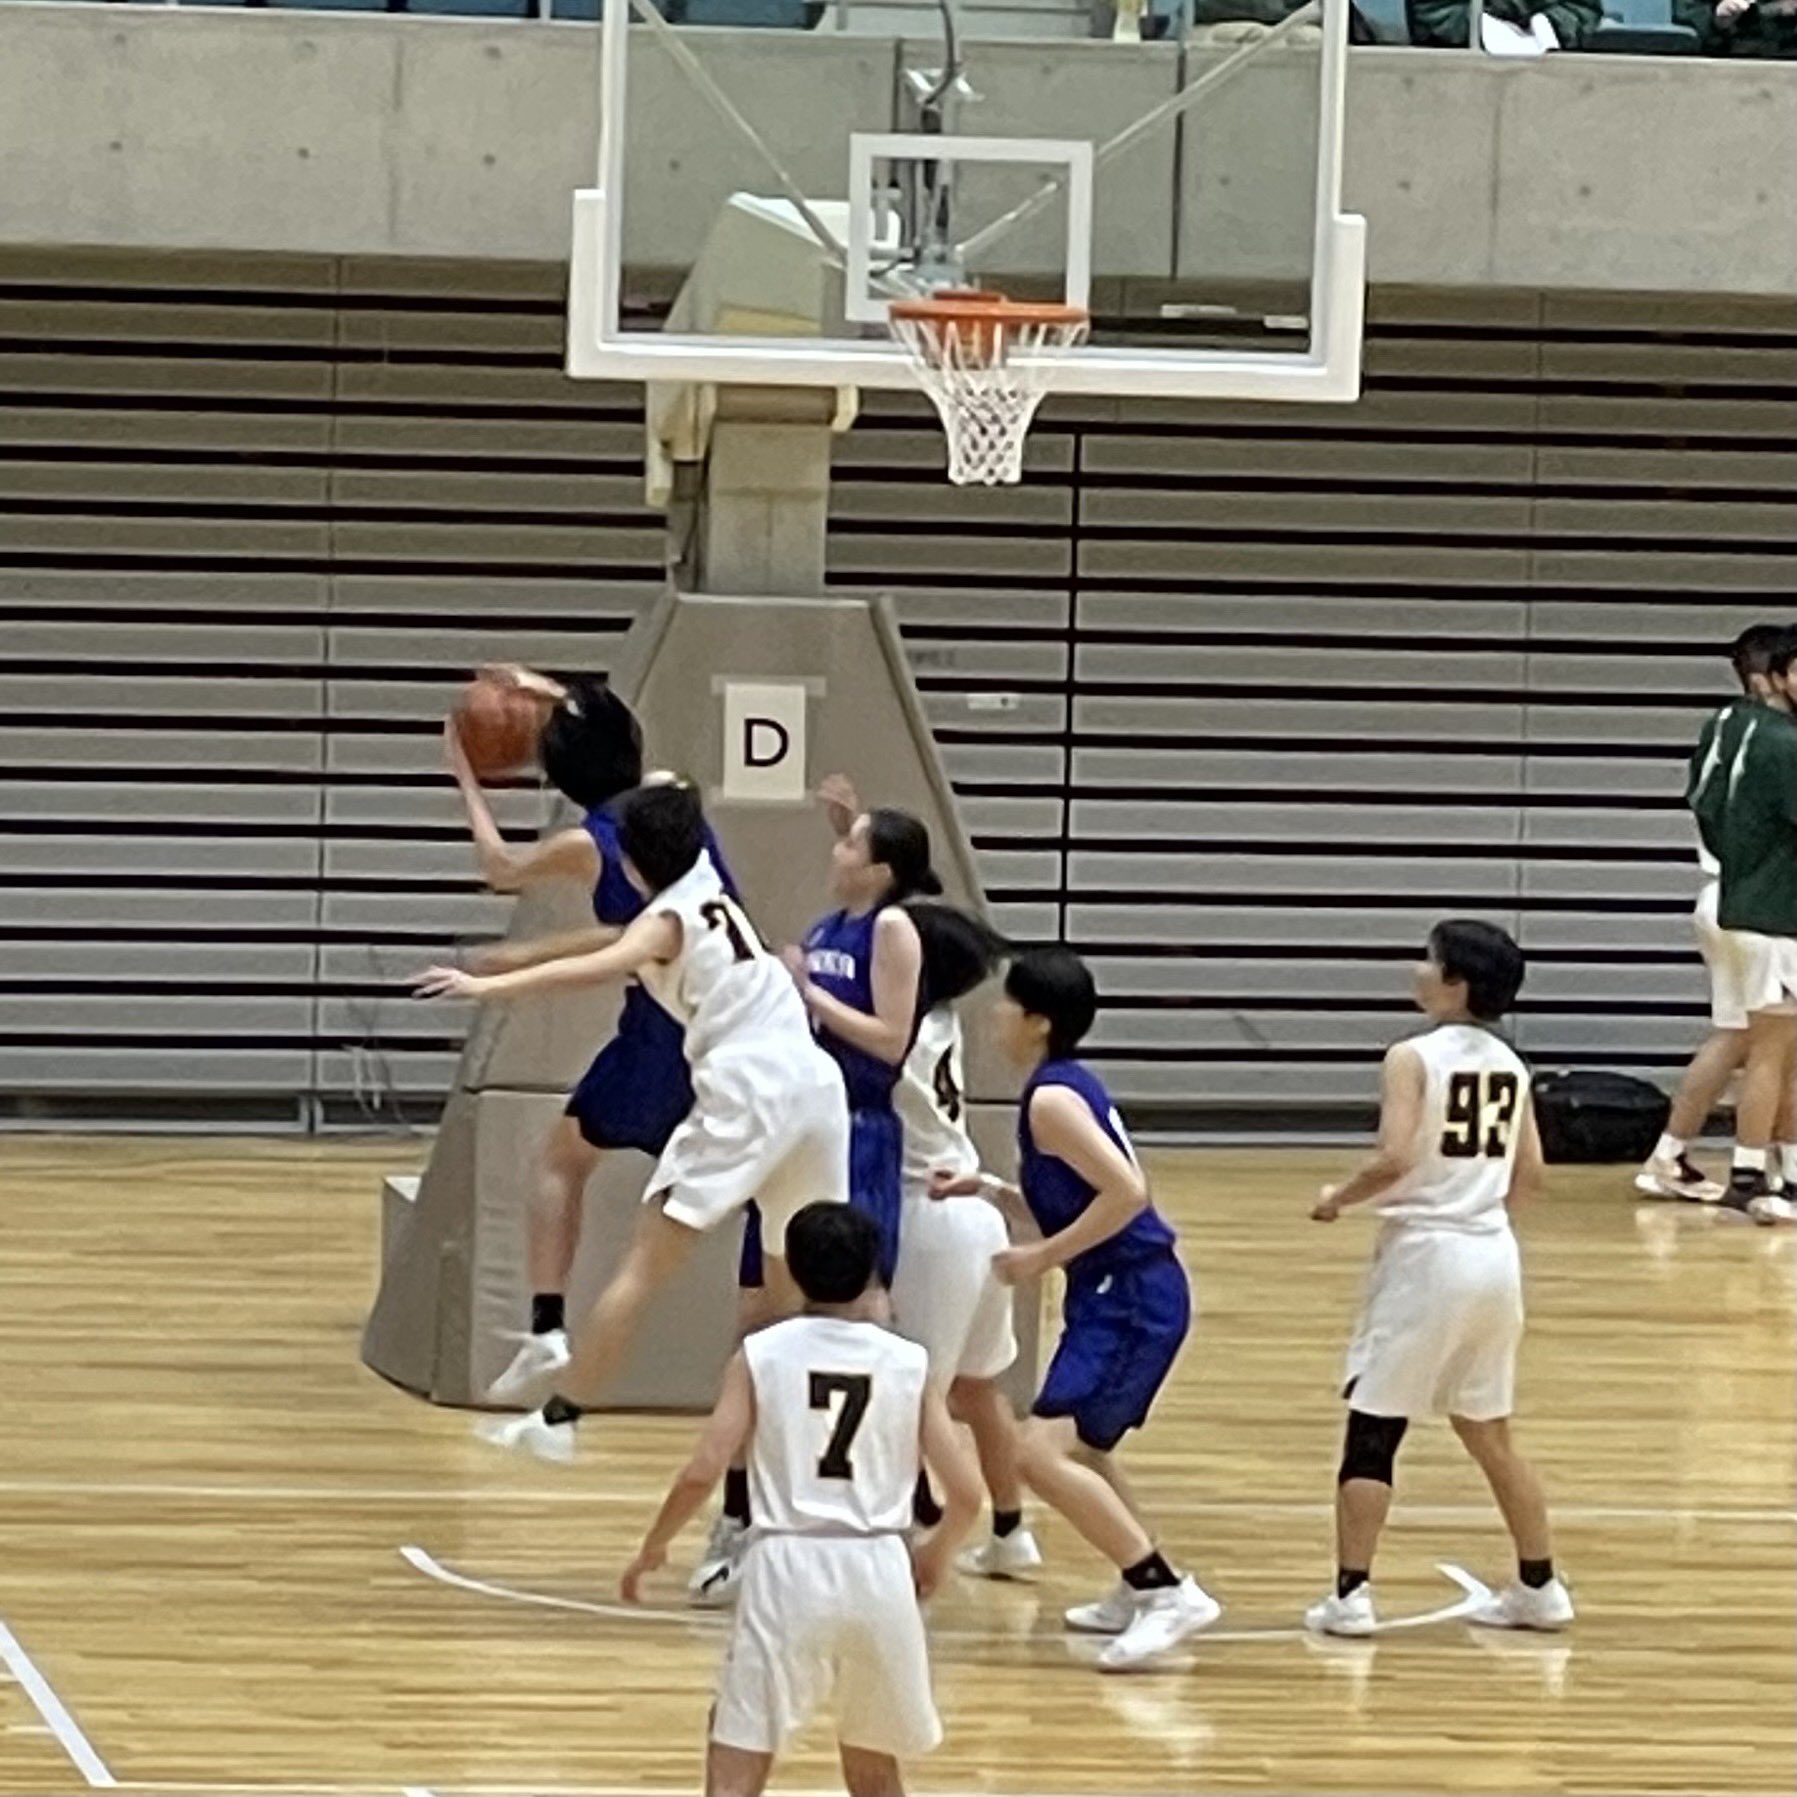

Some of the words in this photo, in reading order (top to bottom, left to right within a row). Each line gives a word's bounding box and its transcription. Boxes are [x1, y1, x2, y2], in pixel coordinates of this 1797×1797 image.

[743, 717, 789, 767] D
[1441, 1071, 1518, 1158] 93
[808, 1371, 872, 1480] 7
